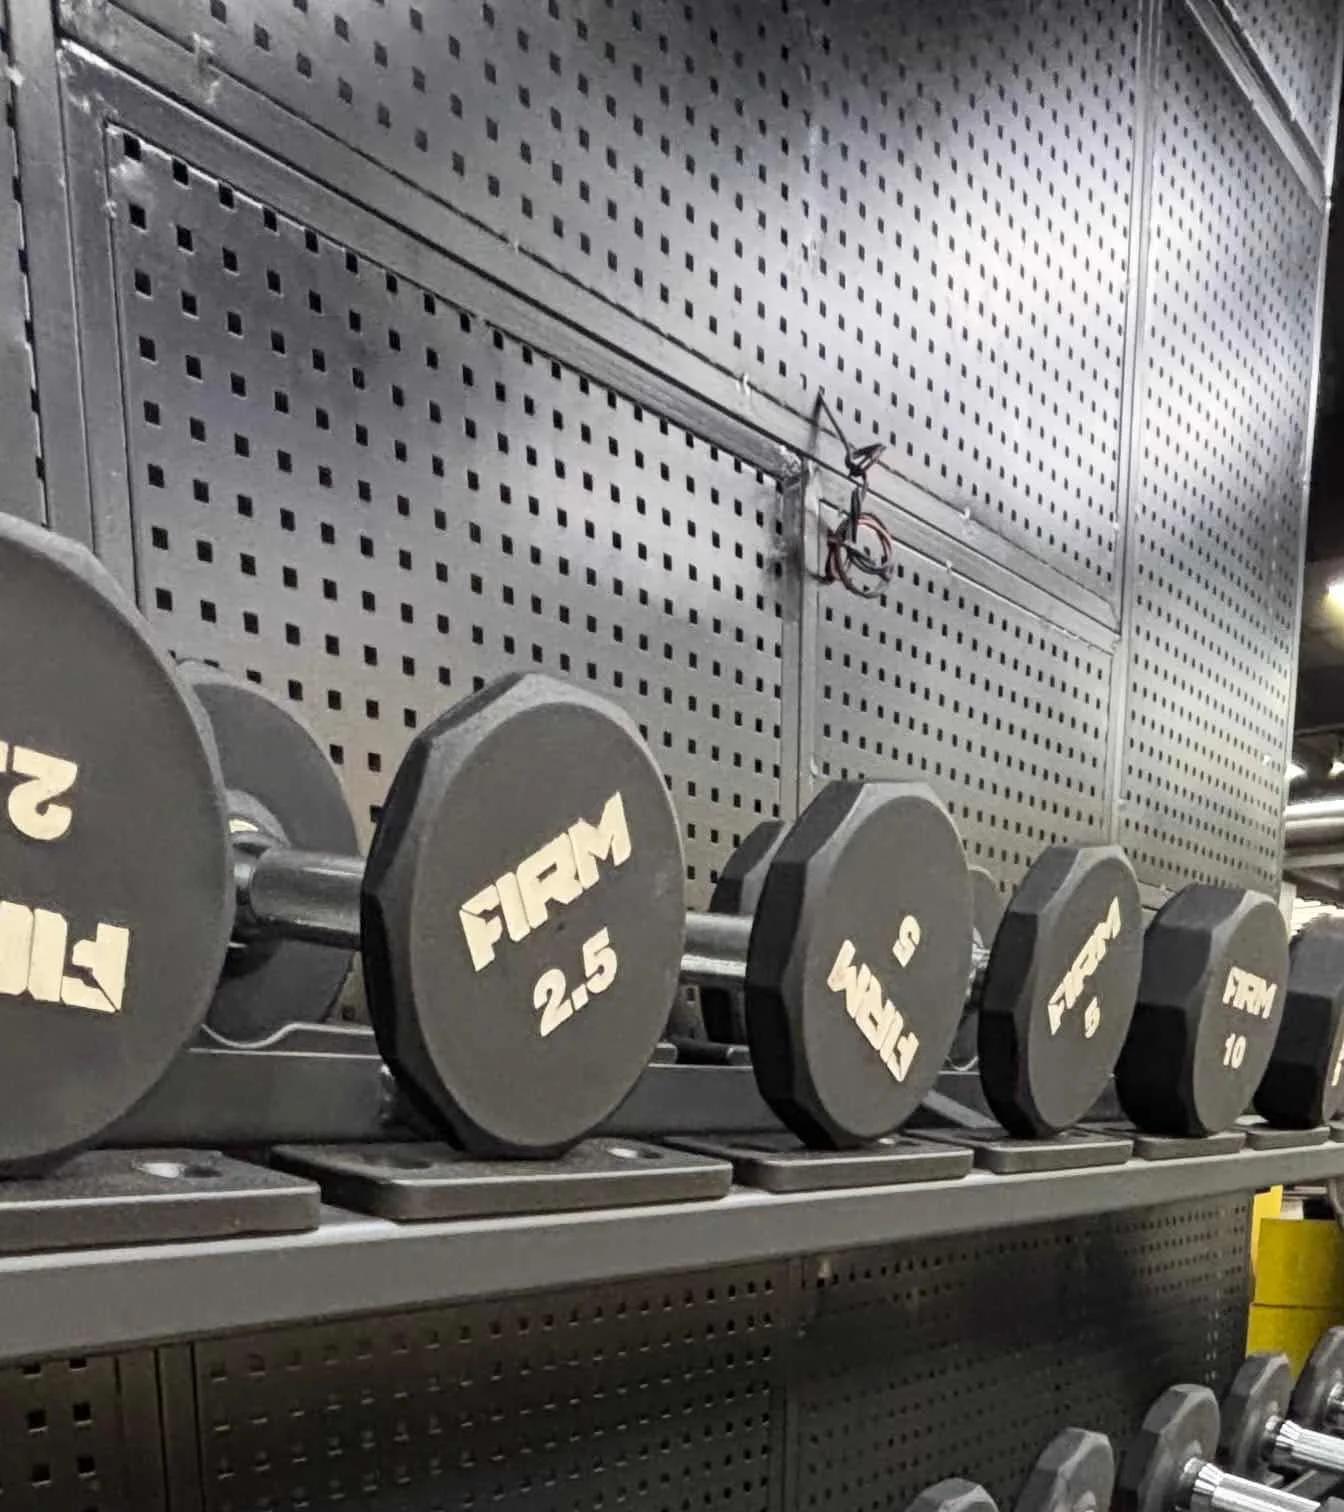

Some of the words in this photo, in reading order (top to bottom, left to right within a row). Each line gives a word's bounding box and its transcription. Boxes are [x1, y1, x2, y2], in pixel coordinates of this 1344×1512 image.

[458, 791, 632, 972] FIRM
[533, 926, 618, 1038] 2.5
[892, 914, 921, 968] 5
[1047, 895, 1122, 1036] FIRM
[1222, 966, 1278, 1020] FIRM
[826, 939, 920, 1083] FIRM
[1223, 1032, 1247, 1069] 10
